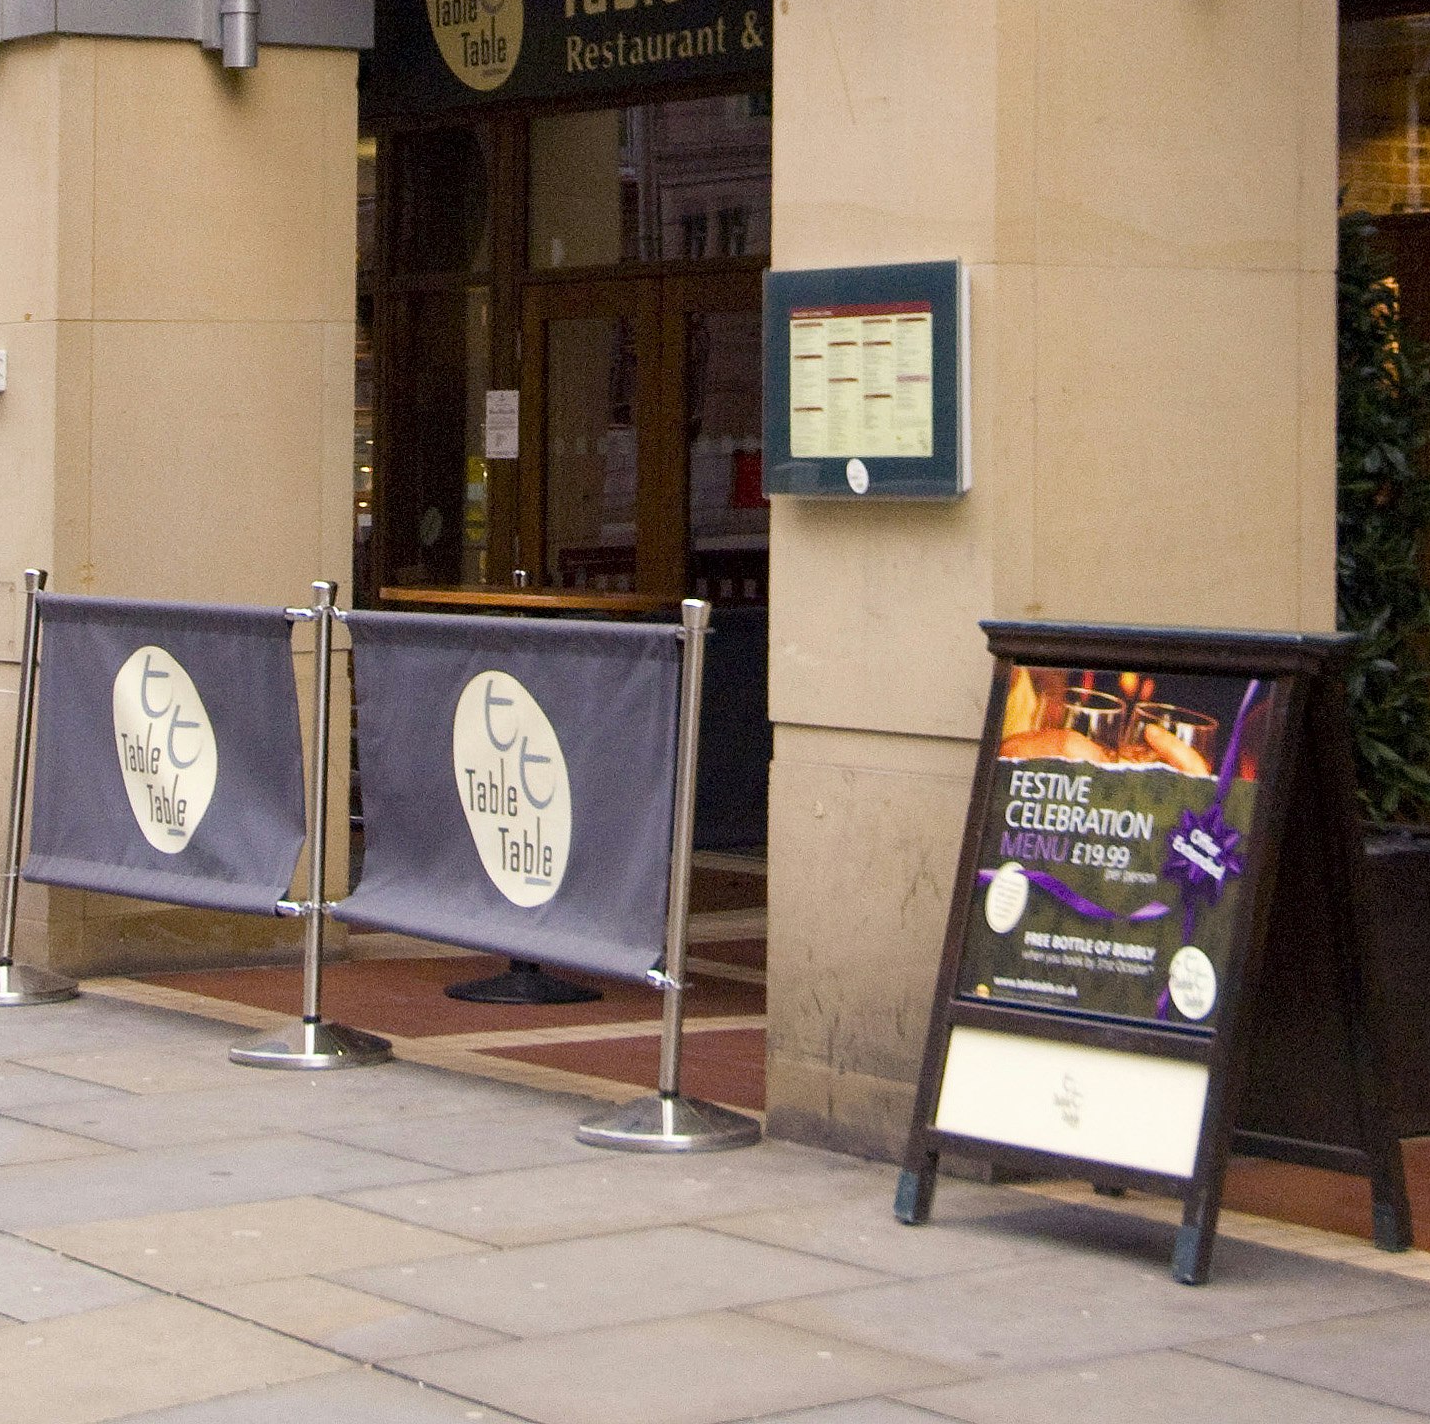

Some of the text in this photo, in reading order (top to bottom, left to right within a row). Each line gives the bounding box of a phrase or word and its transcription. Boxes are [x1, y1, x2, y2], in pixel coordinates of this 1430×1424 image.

[461, 16, 507, 67] Table
[567, 10, 764, 74] Restaurant &
[121, 723, 160, 775] Table
[147, 774, 187, 826] Table
[465, 758, 518, 817] Table
[1010, 770, 1092, 804] FESTIVE
[1005, 801, 1153, 840] CELEBRATION
[498, 816, 553, 877] Table
[1000, 831, 1130, 869] MENU £19.99
[1052, 934, 1093, 954] BOTTLE
[1094, 940, 1111, 956] OF
